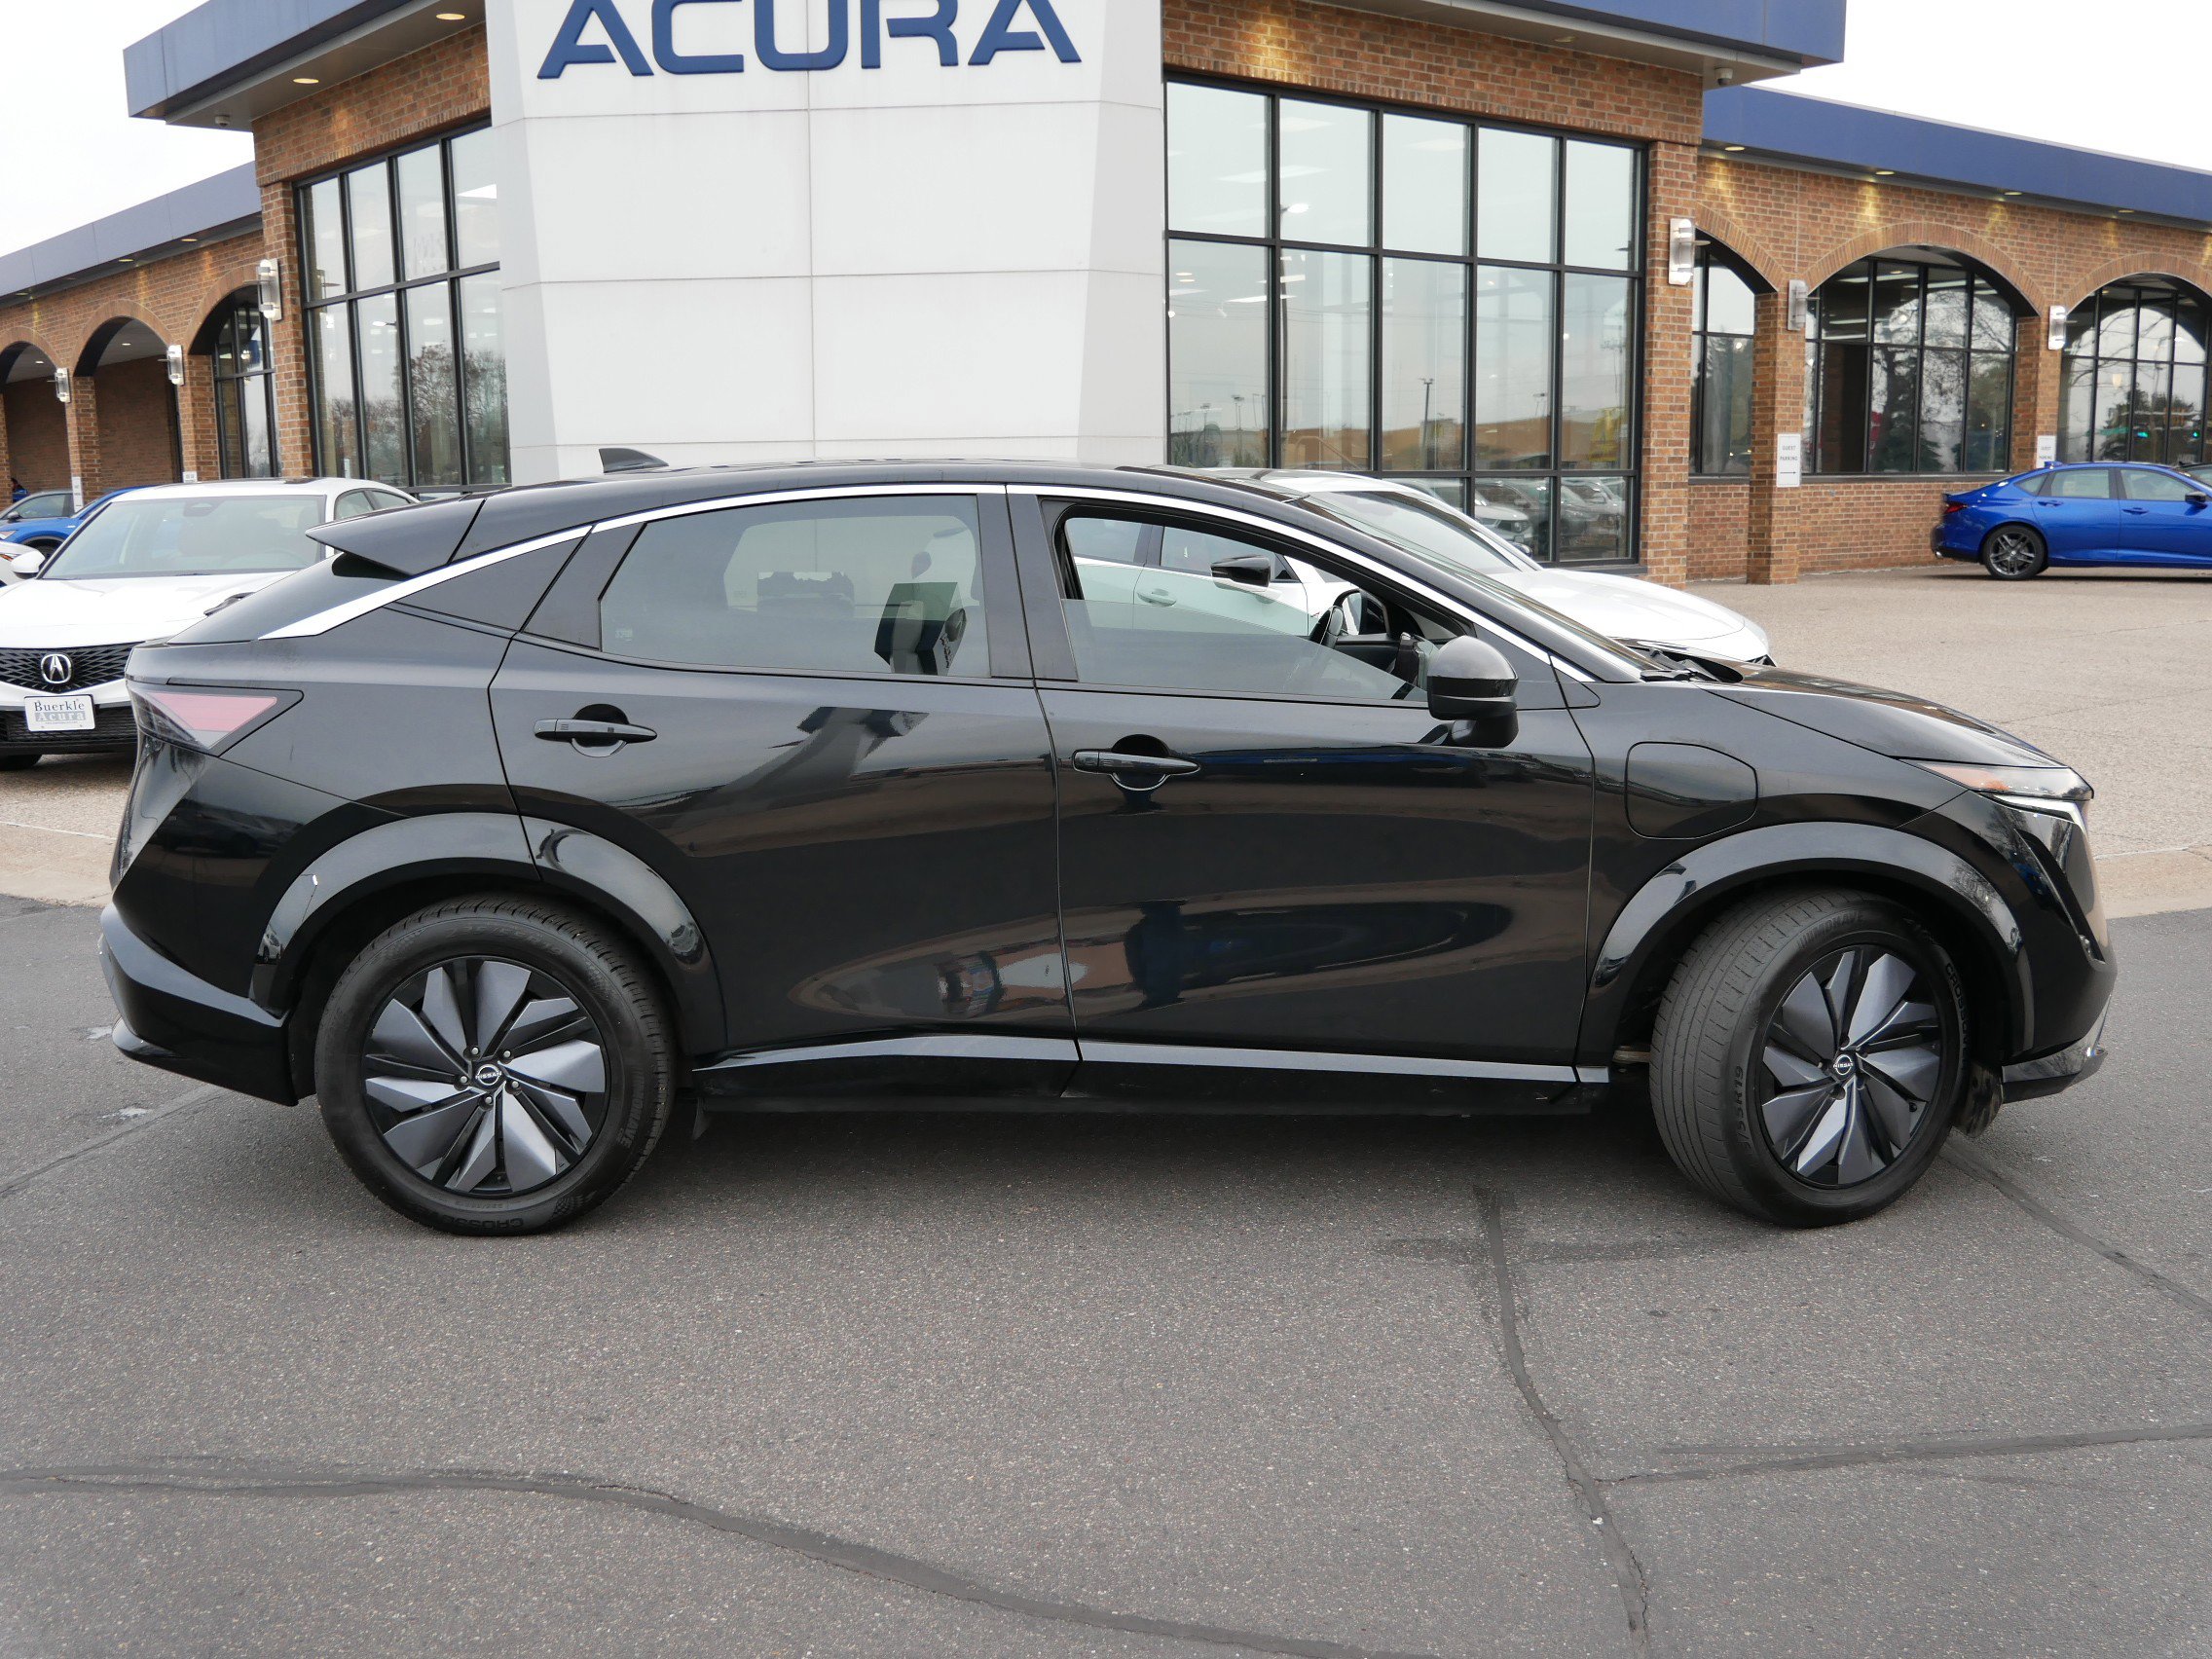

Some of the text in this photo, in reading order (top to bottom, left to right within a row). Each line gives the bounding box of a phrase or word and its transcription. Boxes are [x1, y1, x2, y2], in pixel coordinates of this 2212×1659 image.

[536, 0, 1083, 79] ACURA
[34, 700, 85, 712] Buerkle
[37, 712, 85, 720] Acura
[475, 1071, 502, 1080] NISSAN
